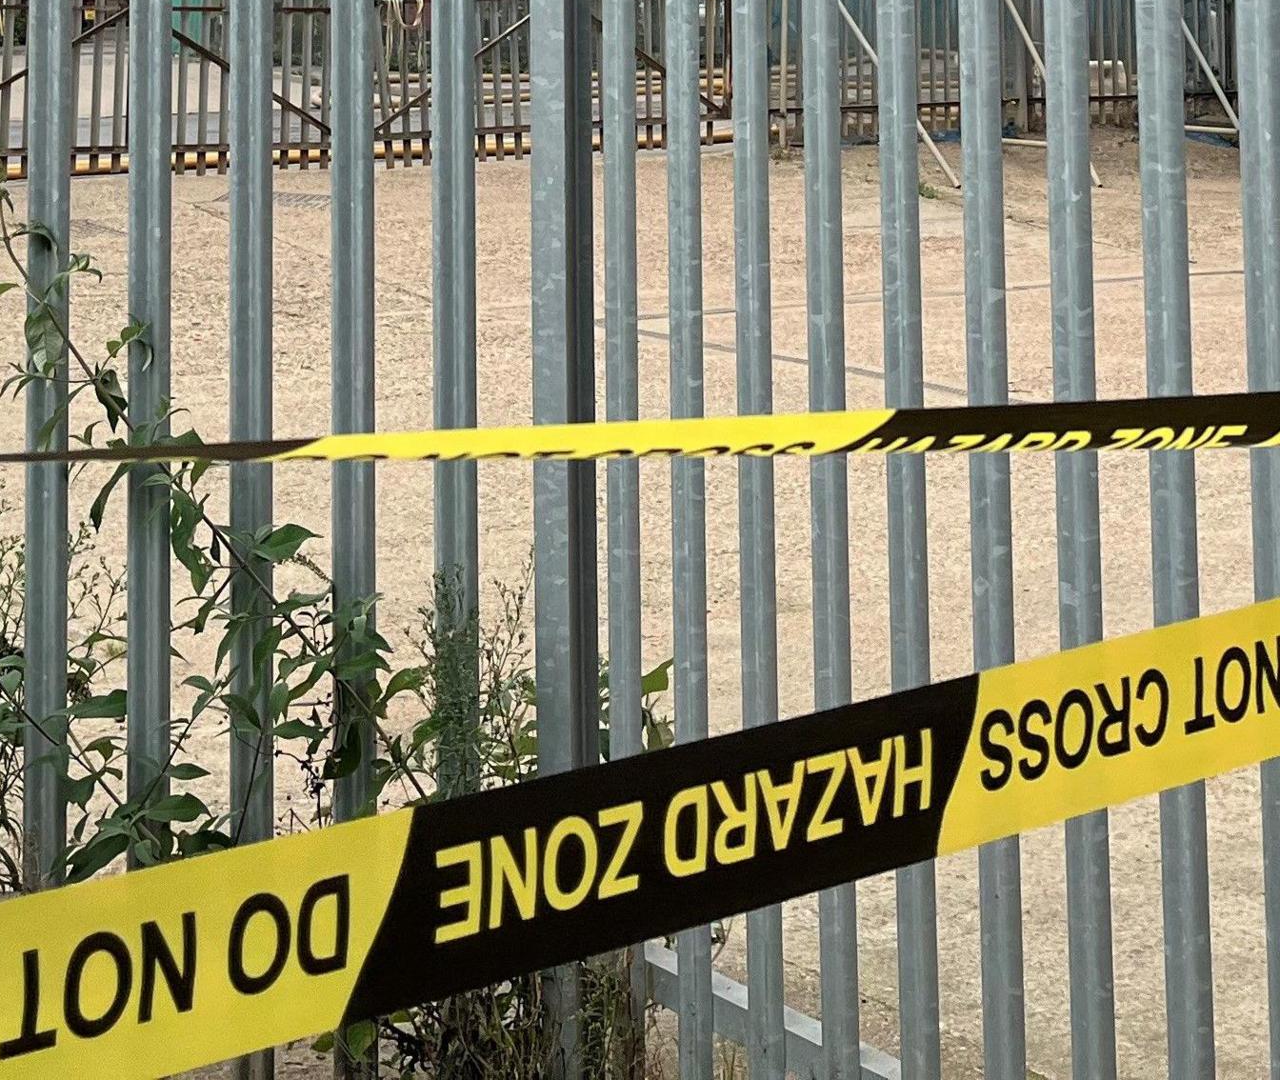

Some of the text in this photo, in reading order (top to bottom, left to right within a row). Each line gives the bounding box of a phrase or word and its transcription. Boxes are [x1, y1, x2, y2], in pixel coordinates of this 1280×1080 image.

[979, 667, 1170, 792] CROSS
[434, 727, 933, 945] HAZARD ZONE
[227, 873, 350, 996] DO
